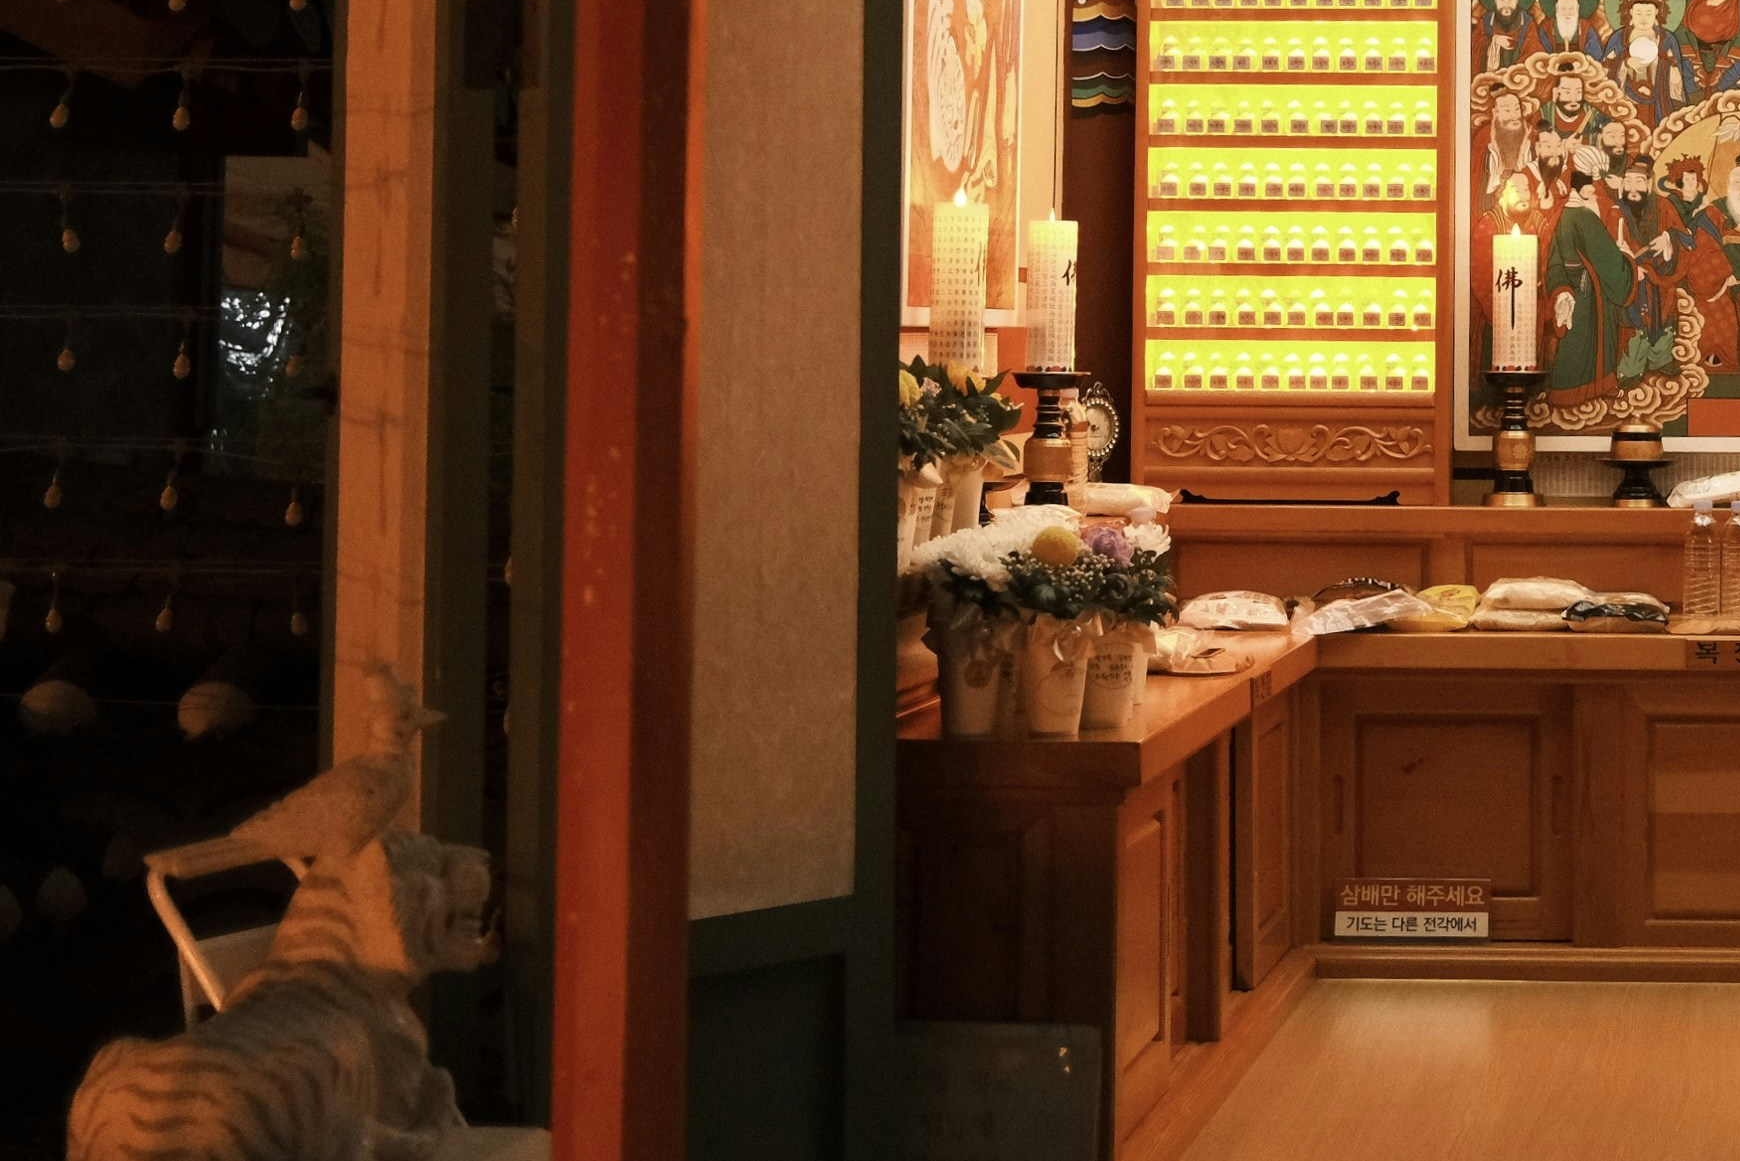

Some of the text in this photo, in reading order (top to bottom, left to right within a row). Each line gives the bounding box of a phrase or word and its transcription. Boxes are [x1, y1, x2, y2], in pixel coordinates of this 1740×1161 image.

[1495, 266, 1523, 330] 佛
[1340, 884, 1485, 907] 삼배만 해주세요
[1346, 916, 1478, 932] 기도는 다른 전각에서
